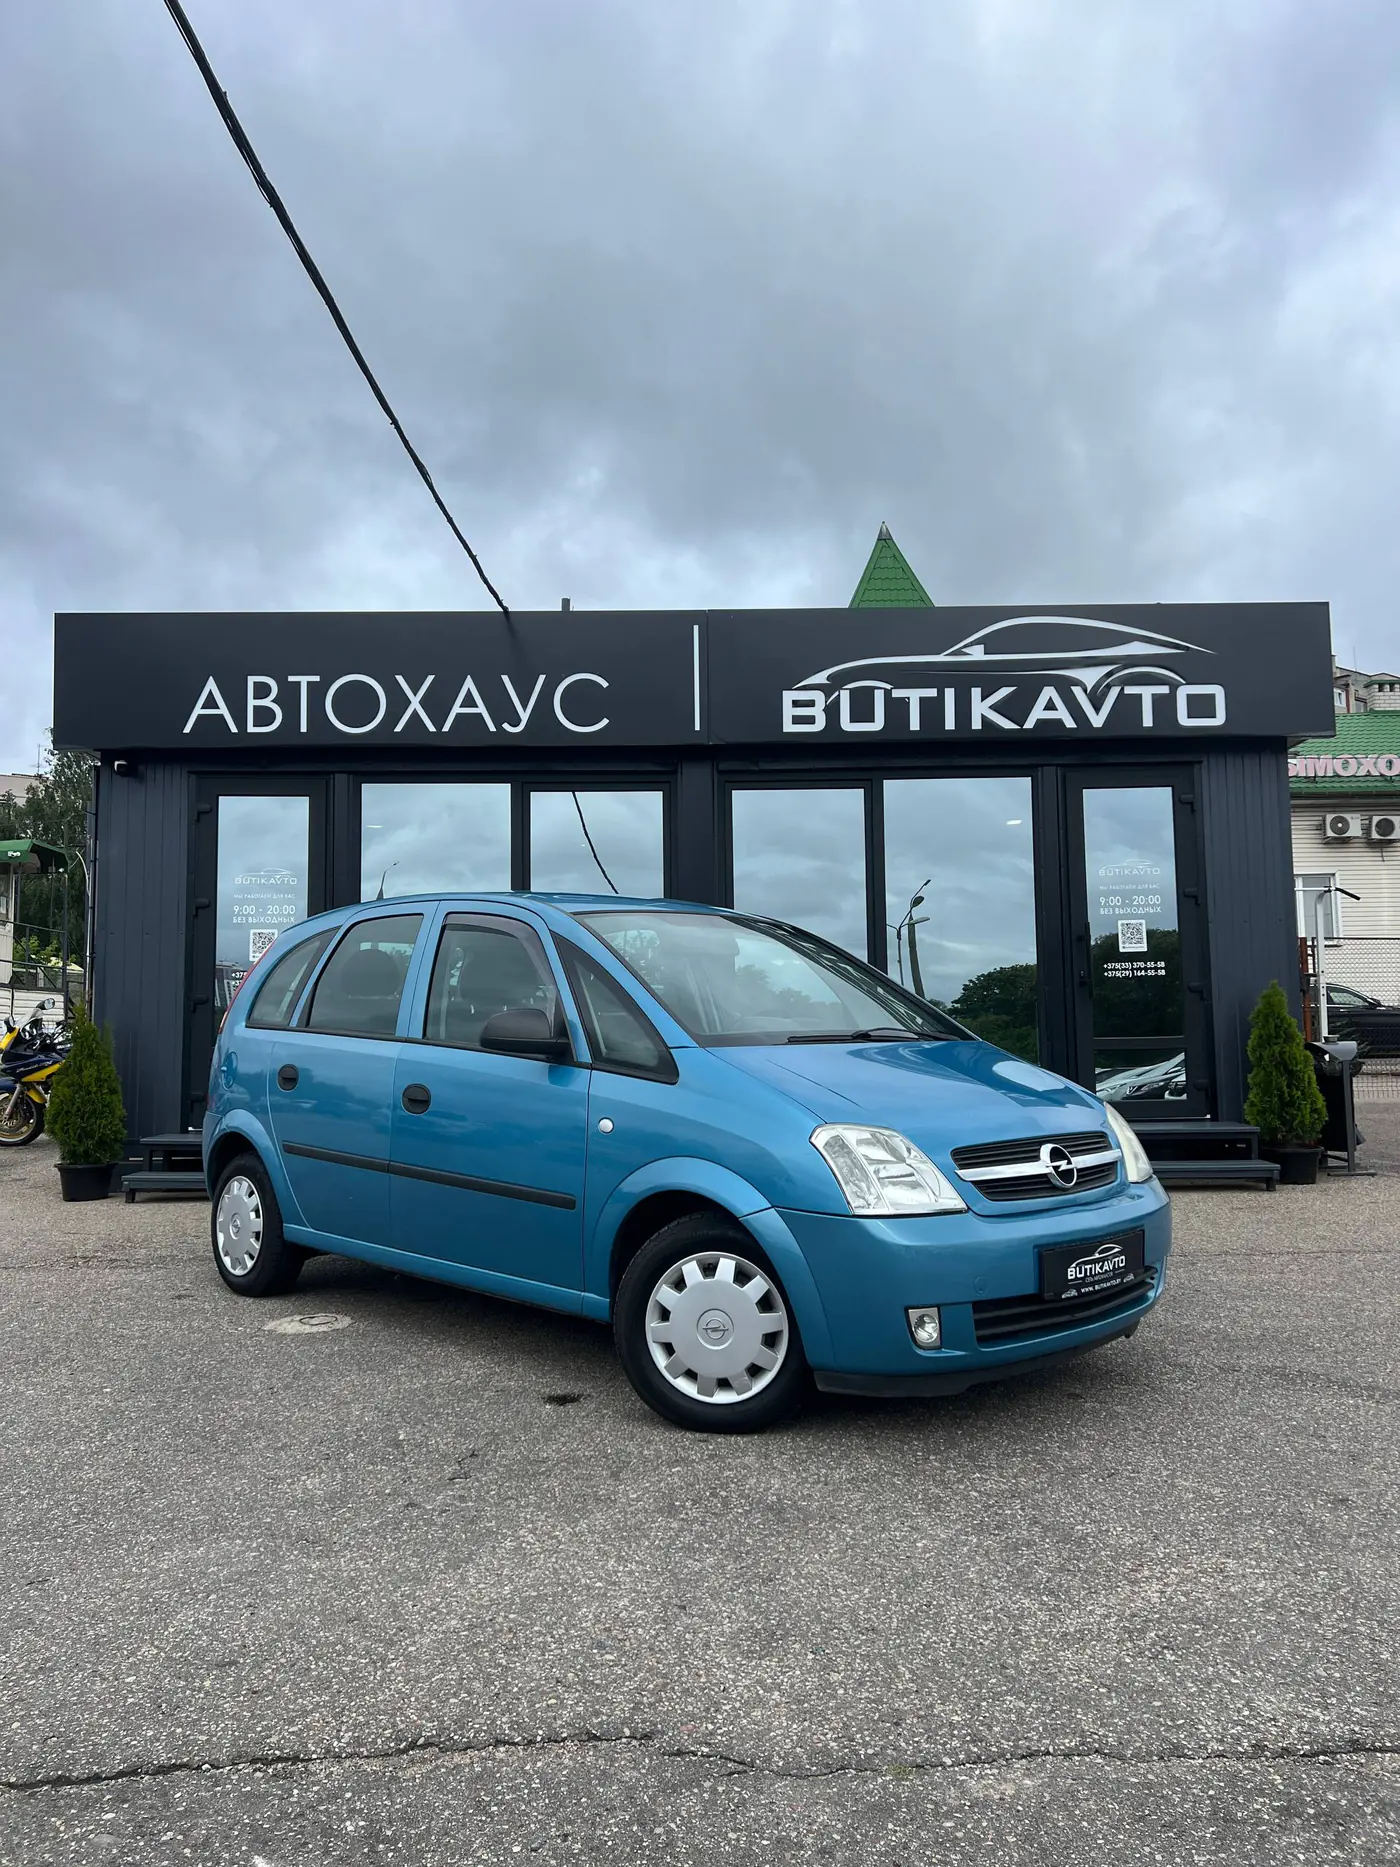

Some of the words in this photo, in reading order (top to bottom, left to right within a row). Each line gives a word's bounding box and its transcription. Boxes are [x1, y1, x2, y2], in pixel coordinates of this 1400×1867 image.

[183, 673, 610, 734] АВТОХАУС
[782, 683, 1226, 733] BUTIKAVTO
[1099, 867, 1160, 876] BUTIKAVTO
[234, 876, 298, 885] BUTIKAVTO
[1099, 896, 1122, 906] 9:00
[1132, 895, 1161, 905] 20:00
[233, 905, 256, 914] 9:00
[266, 905, 296, 914] 20:00
[1100, 907, 1113, 915] БЕЗ
[1115, 906, 1162, 914] ВЫХОДНЫХ
[247, 916, 295, 924] ВЫХОДНЫХ
[1103, 962, 1132, 970] +375(33)
[1103, 970, 1133, 978] +375(29)
[1068, 1255, 1126, 1280] BUTIKAVTO
